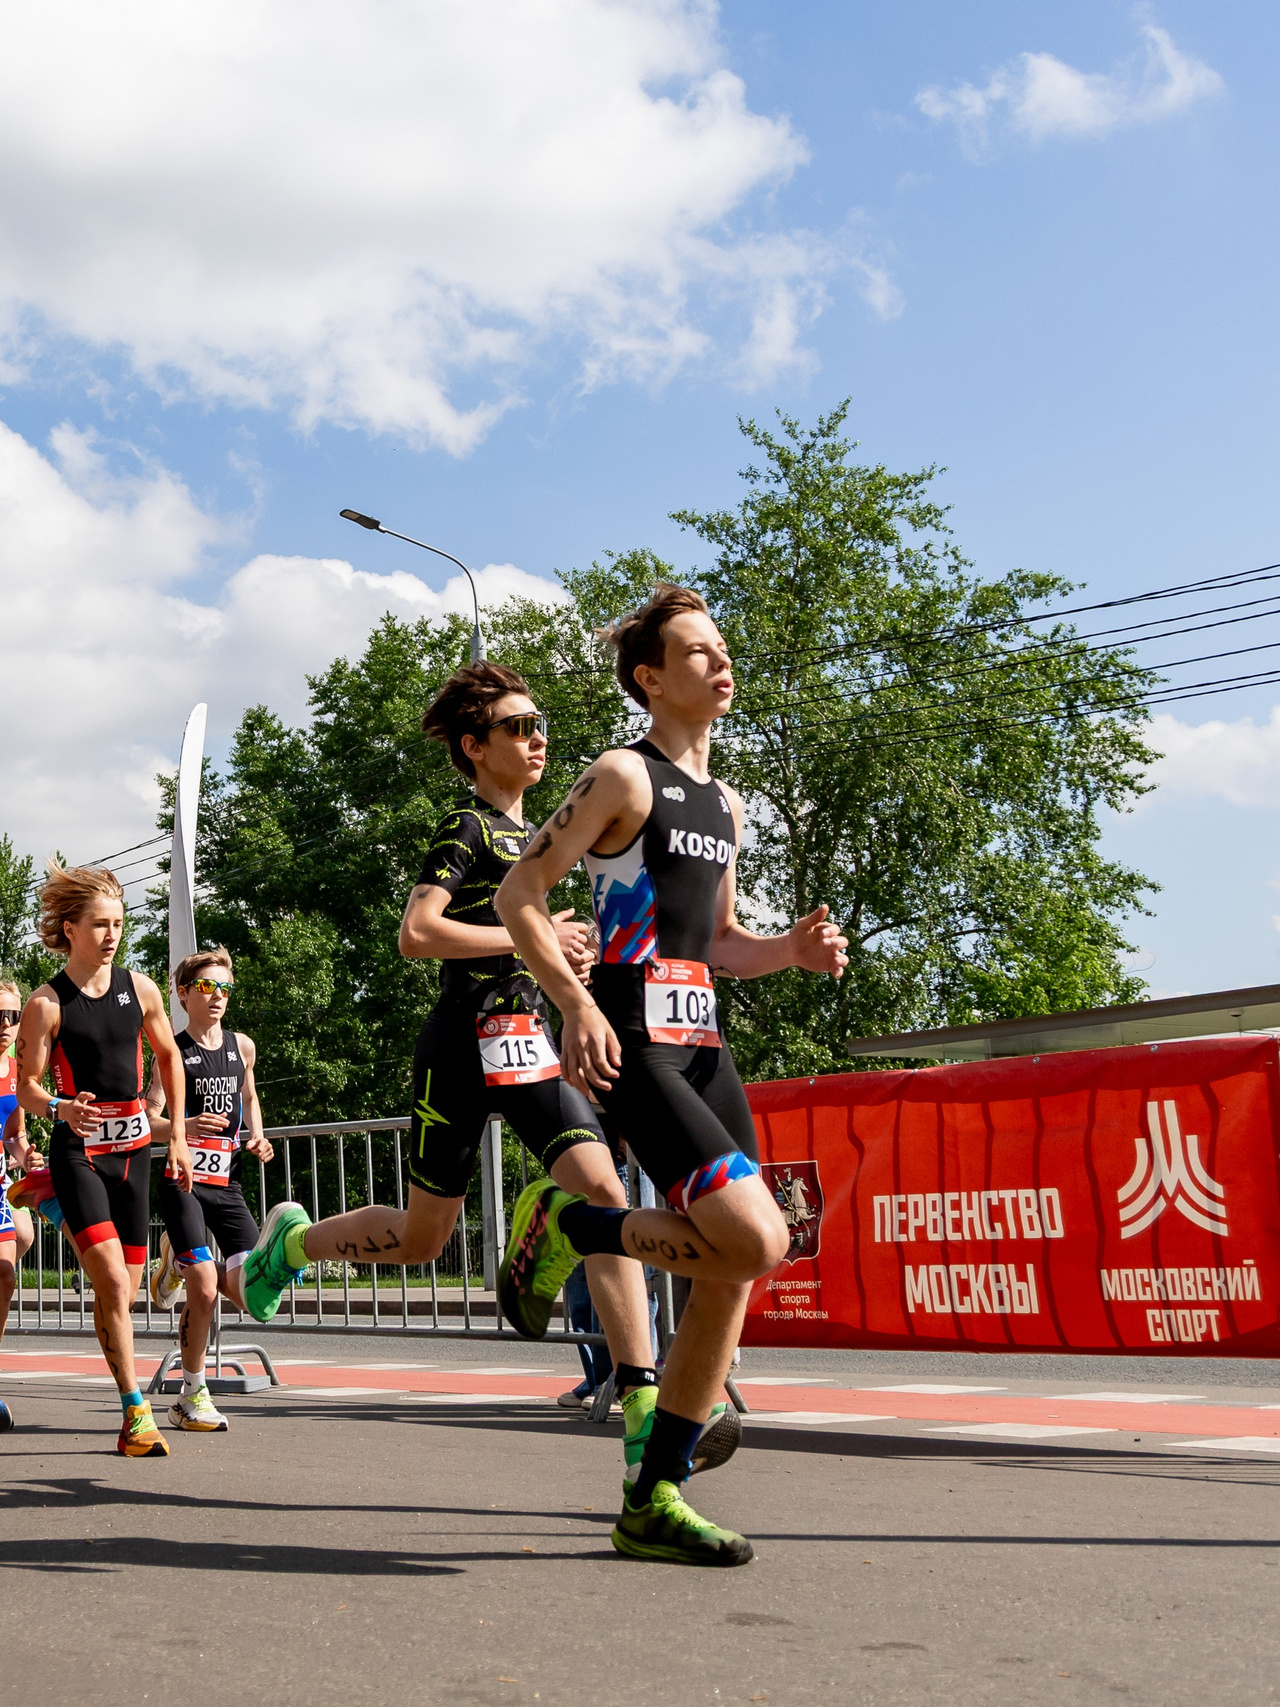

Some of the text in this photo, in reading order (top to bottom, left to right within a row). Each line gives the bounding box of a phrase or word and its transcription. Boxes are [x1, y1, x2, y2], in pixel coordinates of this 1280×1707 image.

[666, 989, 710, 1027] 103
[499, 1039, 541, 1067] 115
[195, 1076, 238, 1095] ROGOZHIN
[203, 1094, 233, 1113] RUS
[99, 1117, 142, 1142] 123
[193, 1151, 221, 1173] 28
[873, 1187, 1065, 1243] ПЕРВЕНСТВО
[765, 1279, 822, 1291] Департамент
[905, 1263, 1040, 1315] МОСКВЫ
[1100, 1260, 1263, 1302] МОСКОВСКИЙ
[780, 1295, 810, 1306] спорта
[763, 1308, 829, 1321] города Москвы
[1147, 1308, 1221, 1343] СПОРТ
